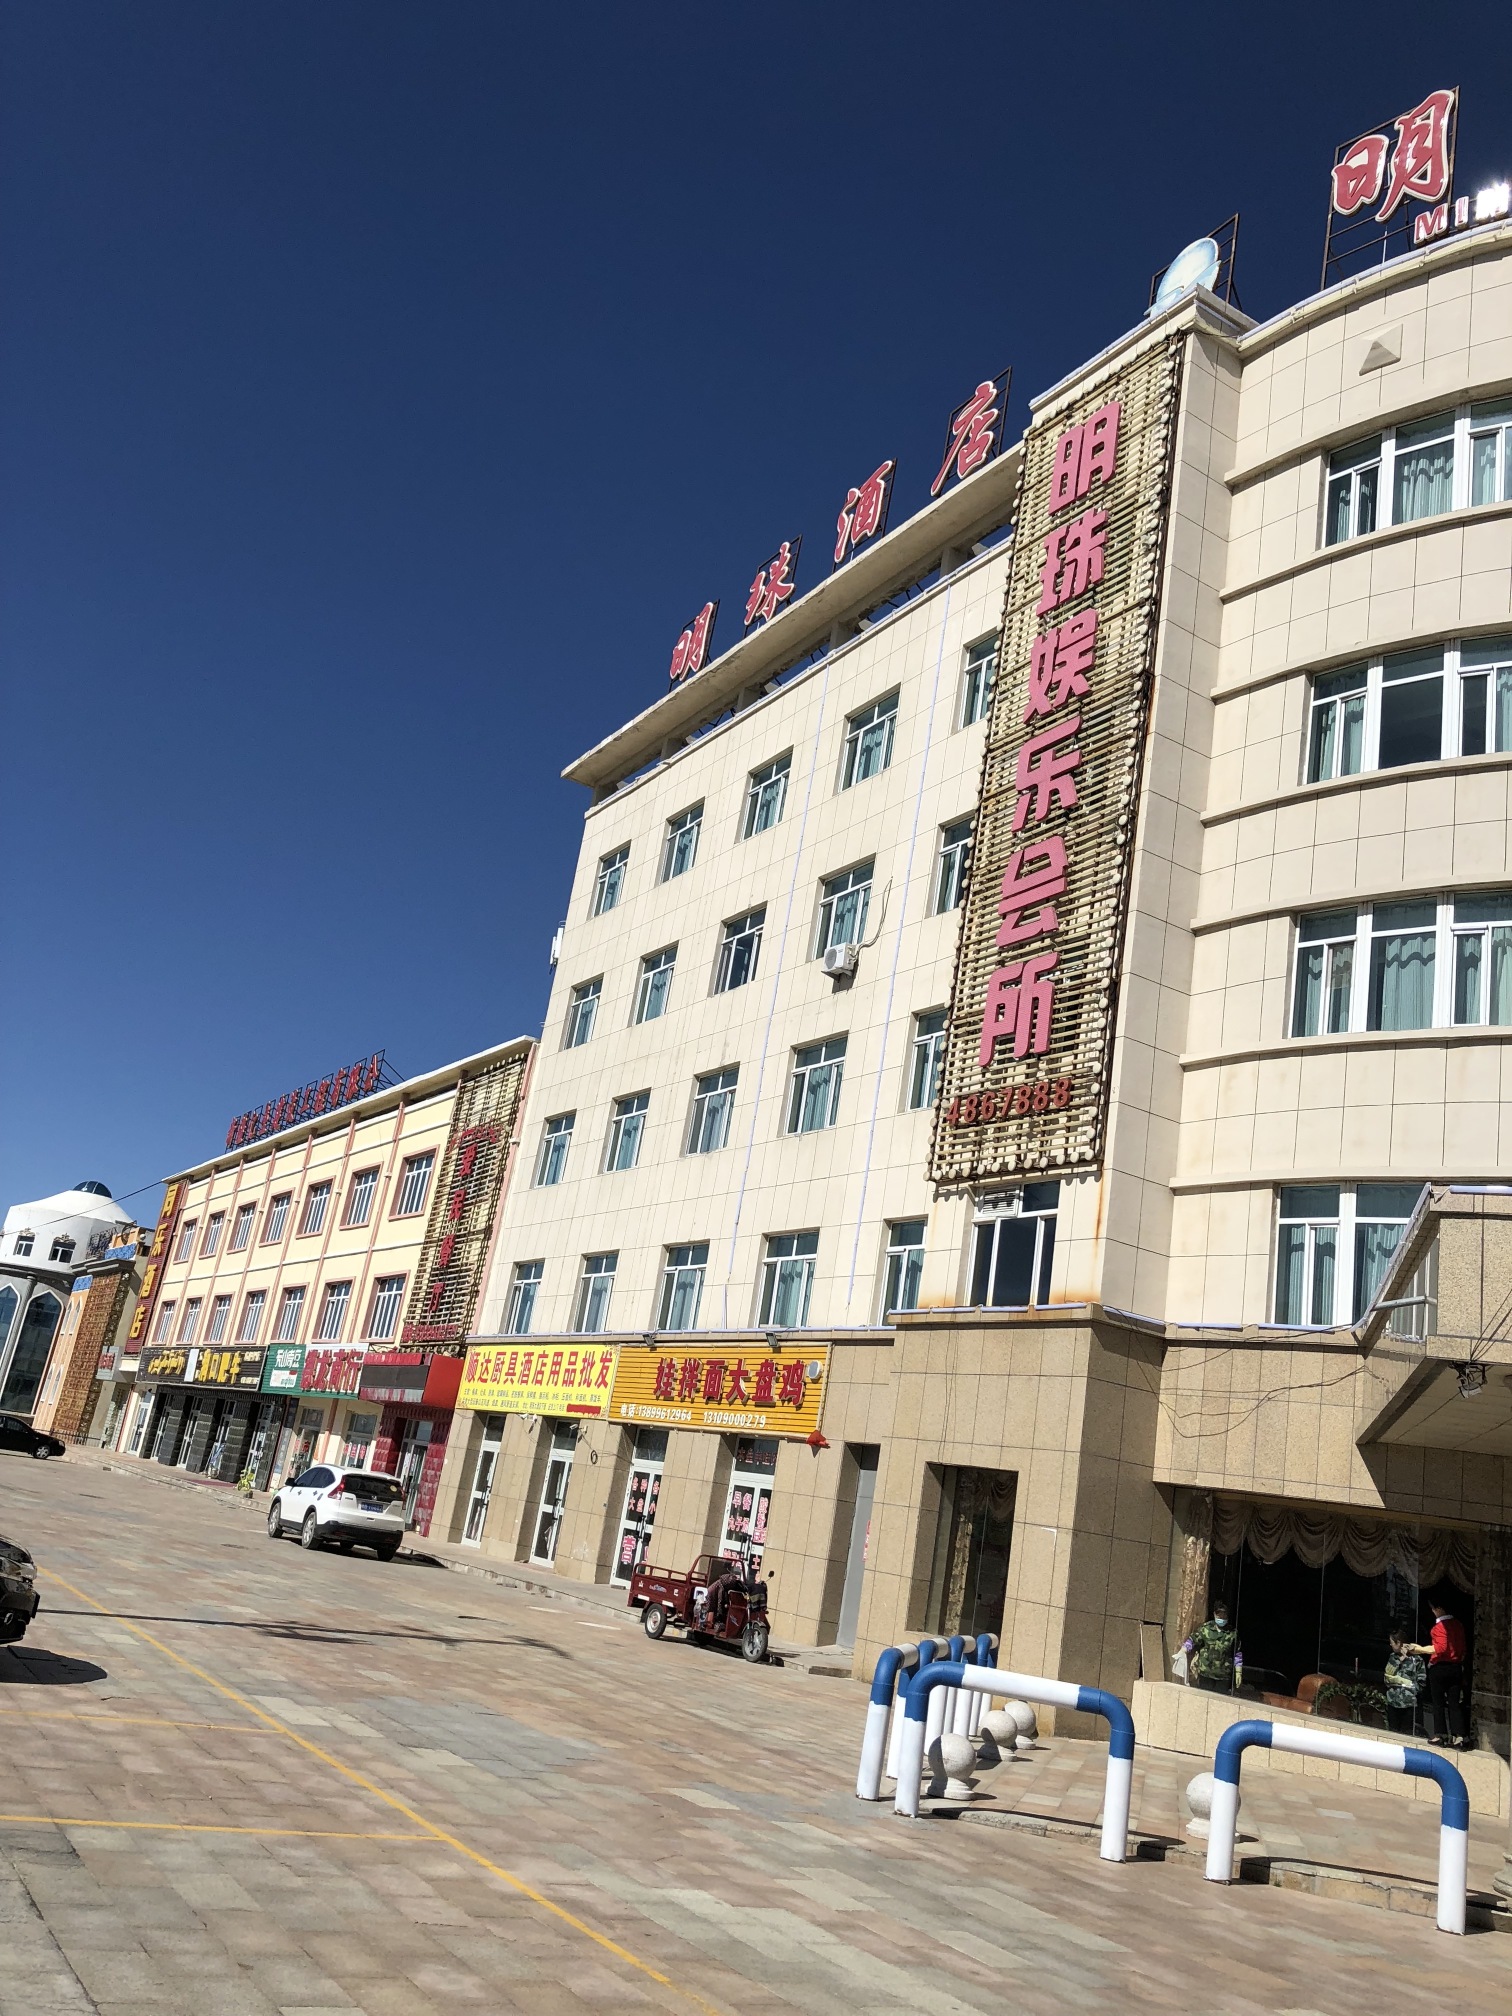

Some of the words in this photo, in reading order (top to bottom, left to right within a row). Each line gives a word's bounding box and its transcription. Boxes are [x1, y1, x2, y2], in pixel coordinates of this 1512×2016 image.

[946, 1077, 1072, 1126] 4867888
[465, 1350, 613, 1389] 顺达厨具酒店用品批发
[703, 1411, 766, 1428] 13109000279
